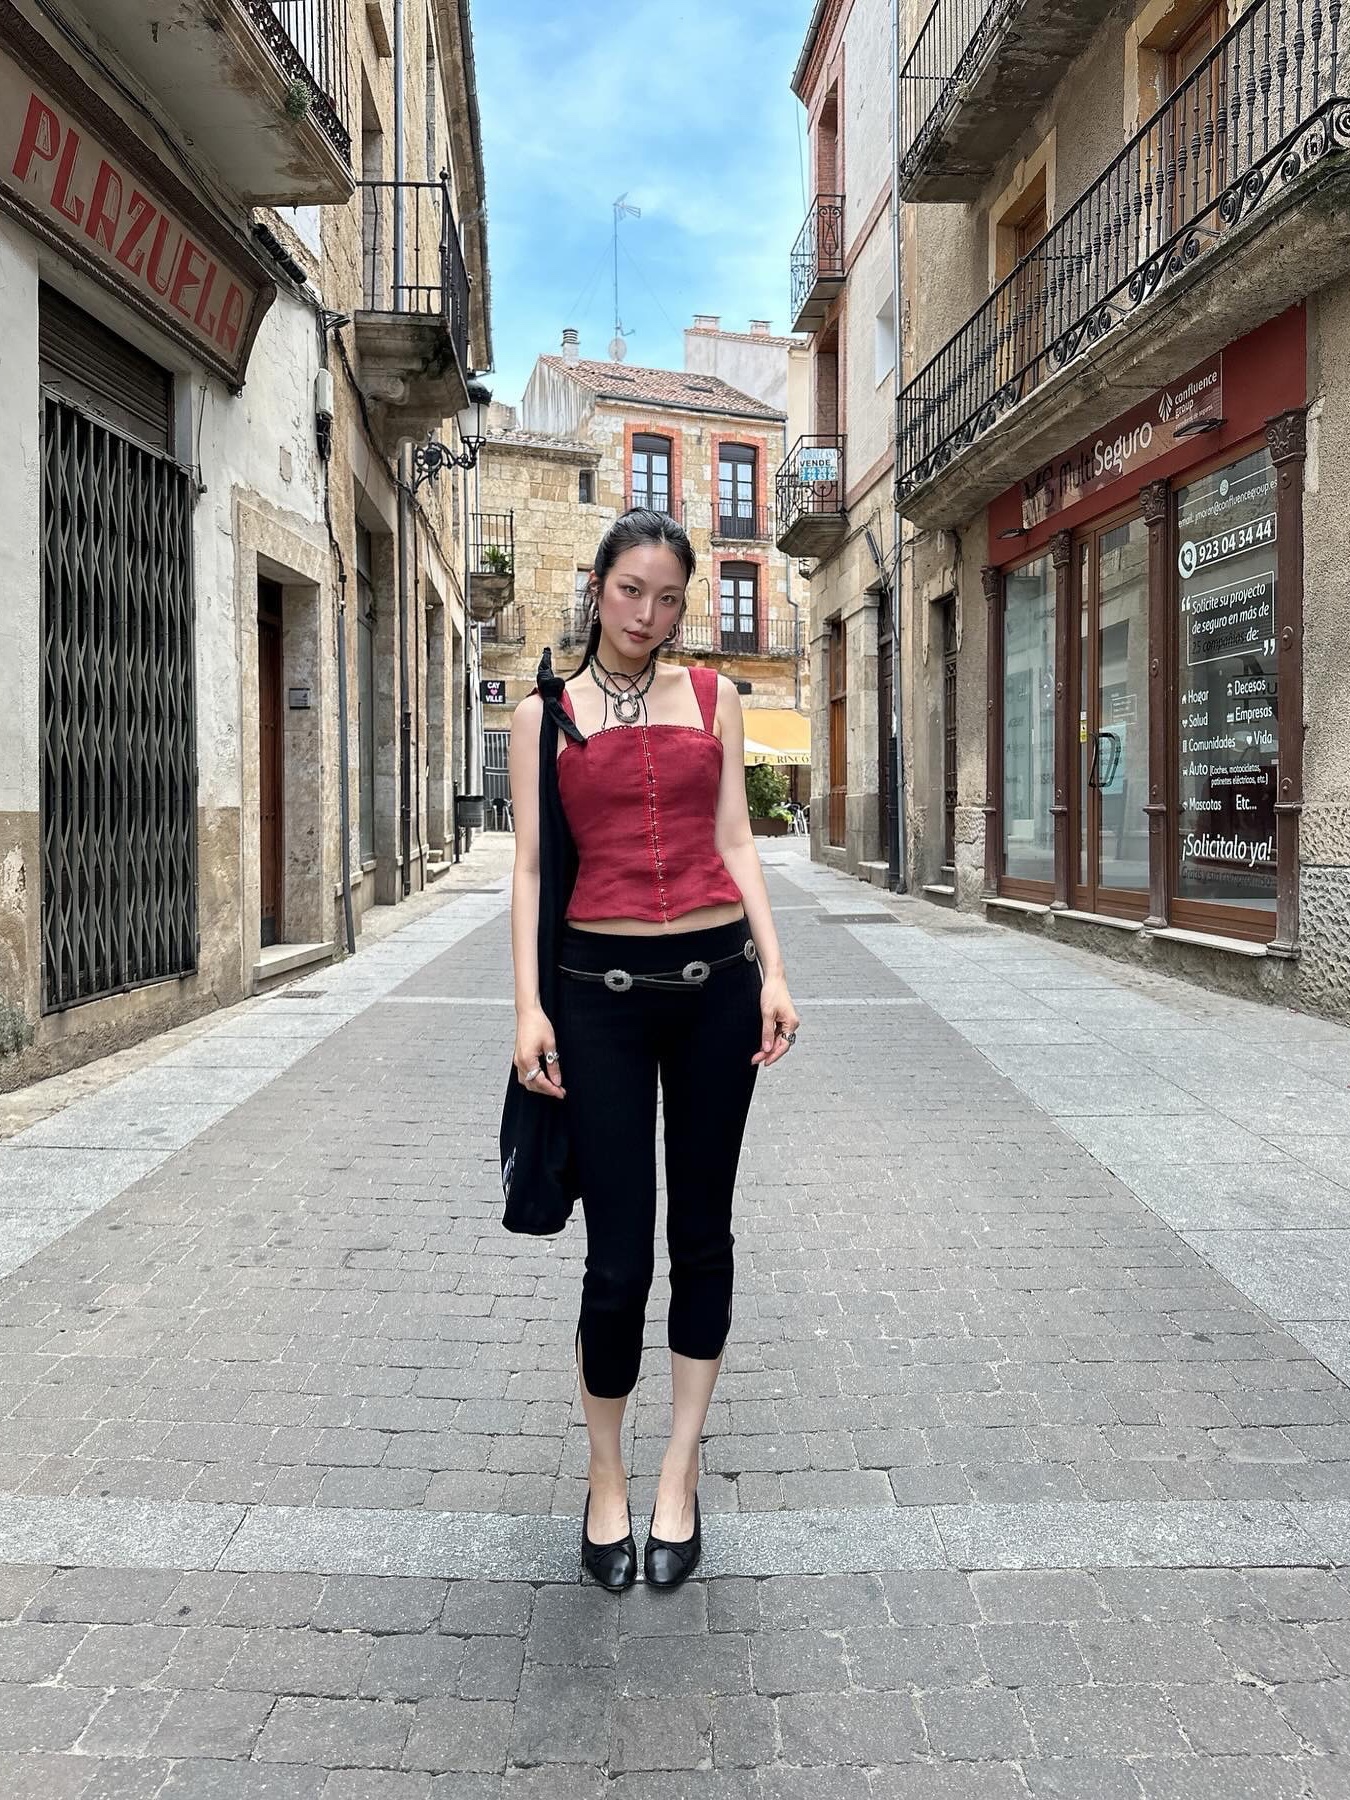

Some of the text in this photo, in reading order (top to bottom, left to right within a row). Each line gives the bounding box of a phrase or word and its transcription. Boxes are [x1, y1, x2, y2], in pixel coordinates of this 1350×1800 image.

[12, 93, 244, 353] PLAZUELA
[1174, 371, 1218, 405] confluence
[1175, 399, 1194, 420] group
[1199, 519, 1272, 563] 923 04 34 44
[1219, 594, 1229, 608] su
[1229, 583, 1266, 608] proyecto
[1191, 601, 1270, 635] de seguro en más de
[1187, 679, 1266, 705] Hogar Decesos
[1188, 706, 1273, 728] Salud Empresas
[1188, 729, 1273, 752] Comunidades Vida
[777, 754, 811, 764] RINCÓ
[1188, 761, 1209, 776] Auto
[1189, 794, 1258, 811] Mascotas Etc...
[1248, 835, 1273, 868] ya!
